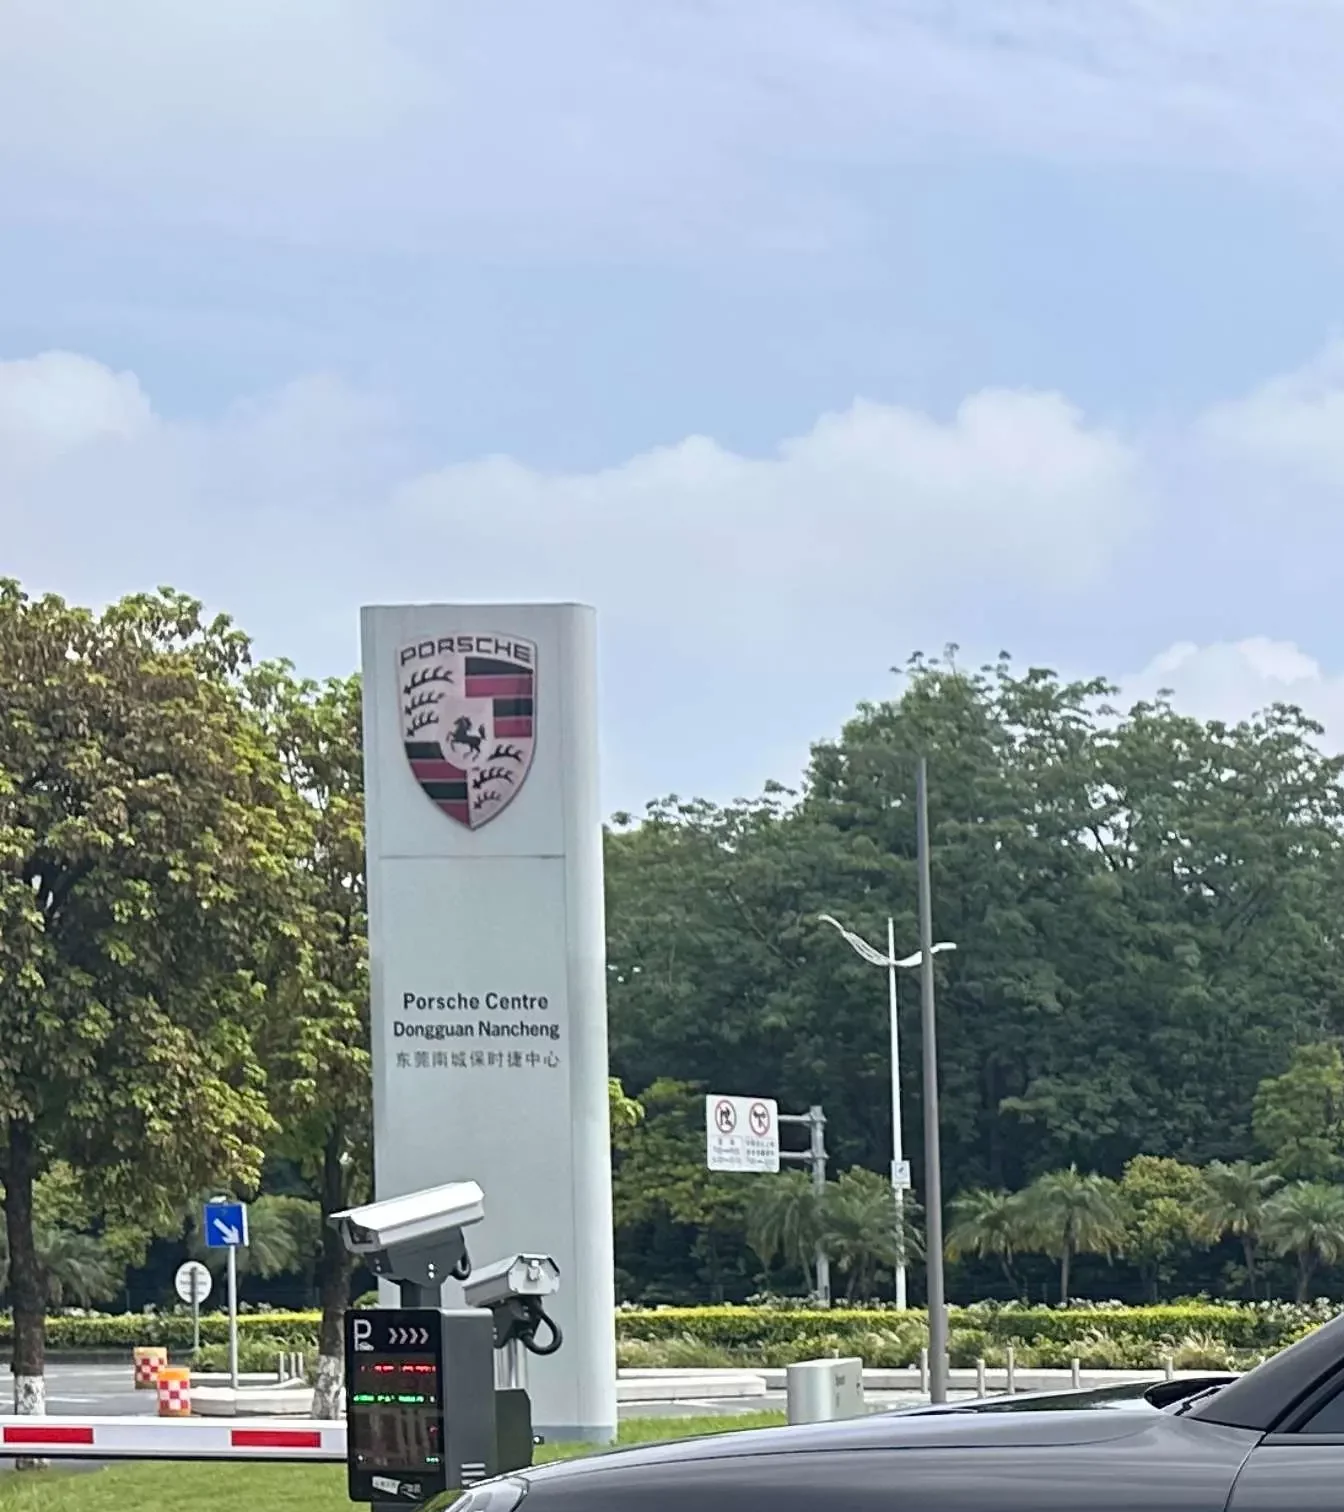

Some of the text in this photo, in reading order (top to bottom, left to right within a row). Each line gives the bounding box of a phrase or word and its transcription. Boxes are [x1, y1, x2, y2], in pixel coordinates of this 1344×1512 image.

[400, 636, 531, 666] PORSCHE
[403, 992, 549, 1010] Porsche Centre
[393, 1020, 560, 1040] Dongguan Nancheng
[396, 1050, 560, 1069] 东莞南城保时捷中心
